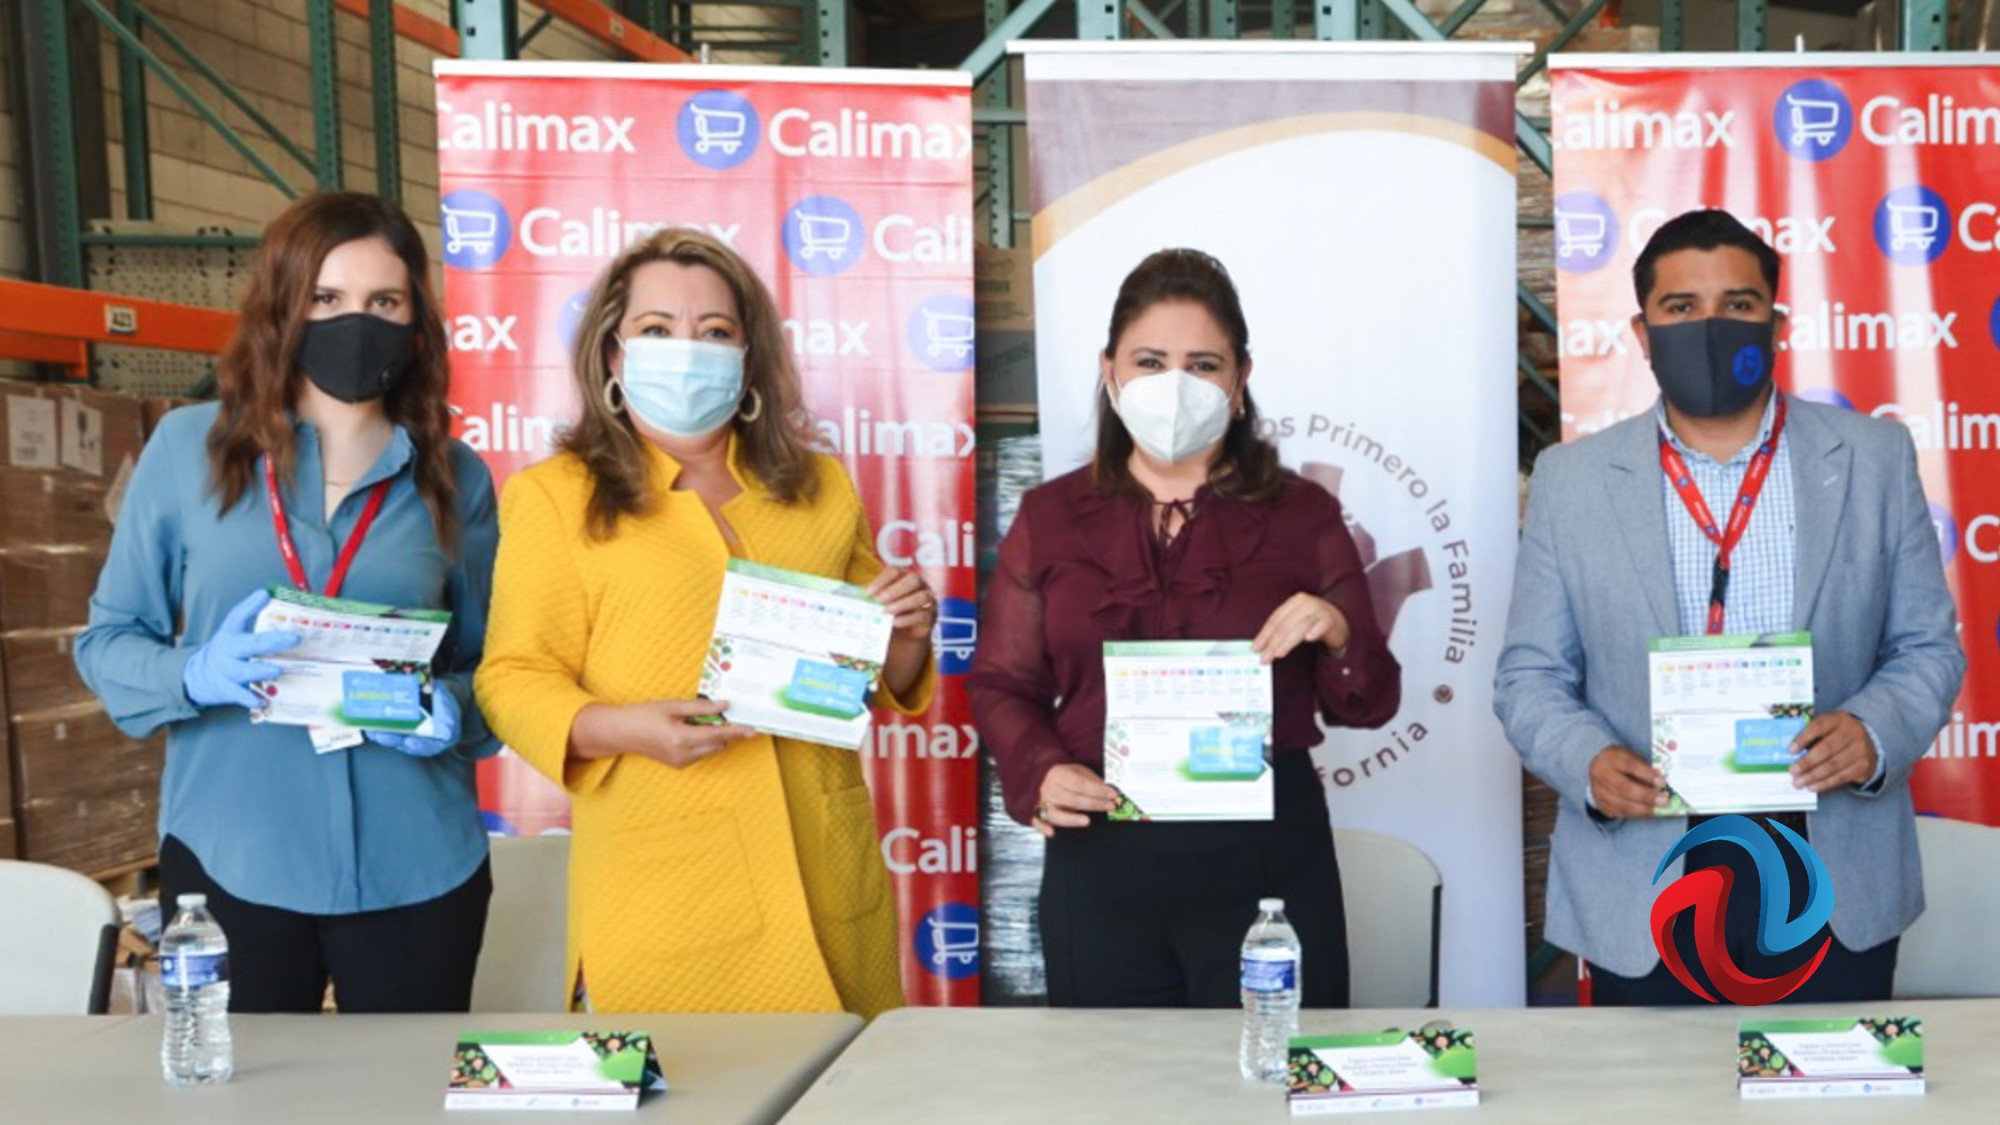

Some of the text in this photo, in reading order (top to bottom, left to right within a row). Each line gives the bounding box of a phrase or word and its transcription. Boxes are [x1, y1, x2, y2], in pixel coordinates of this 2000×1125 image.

[1552, 100, 1736, 149] alimax
[1307, 413, 1428, 499] Primero
[1442, 539, 1478, 665] Familia
